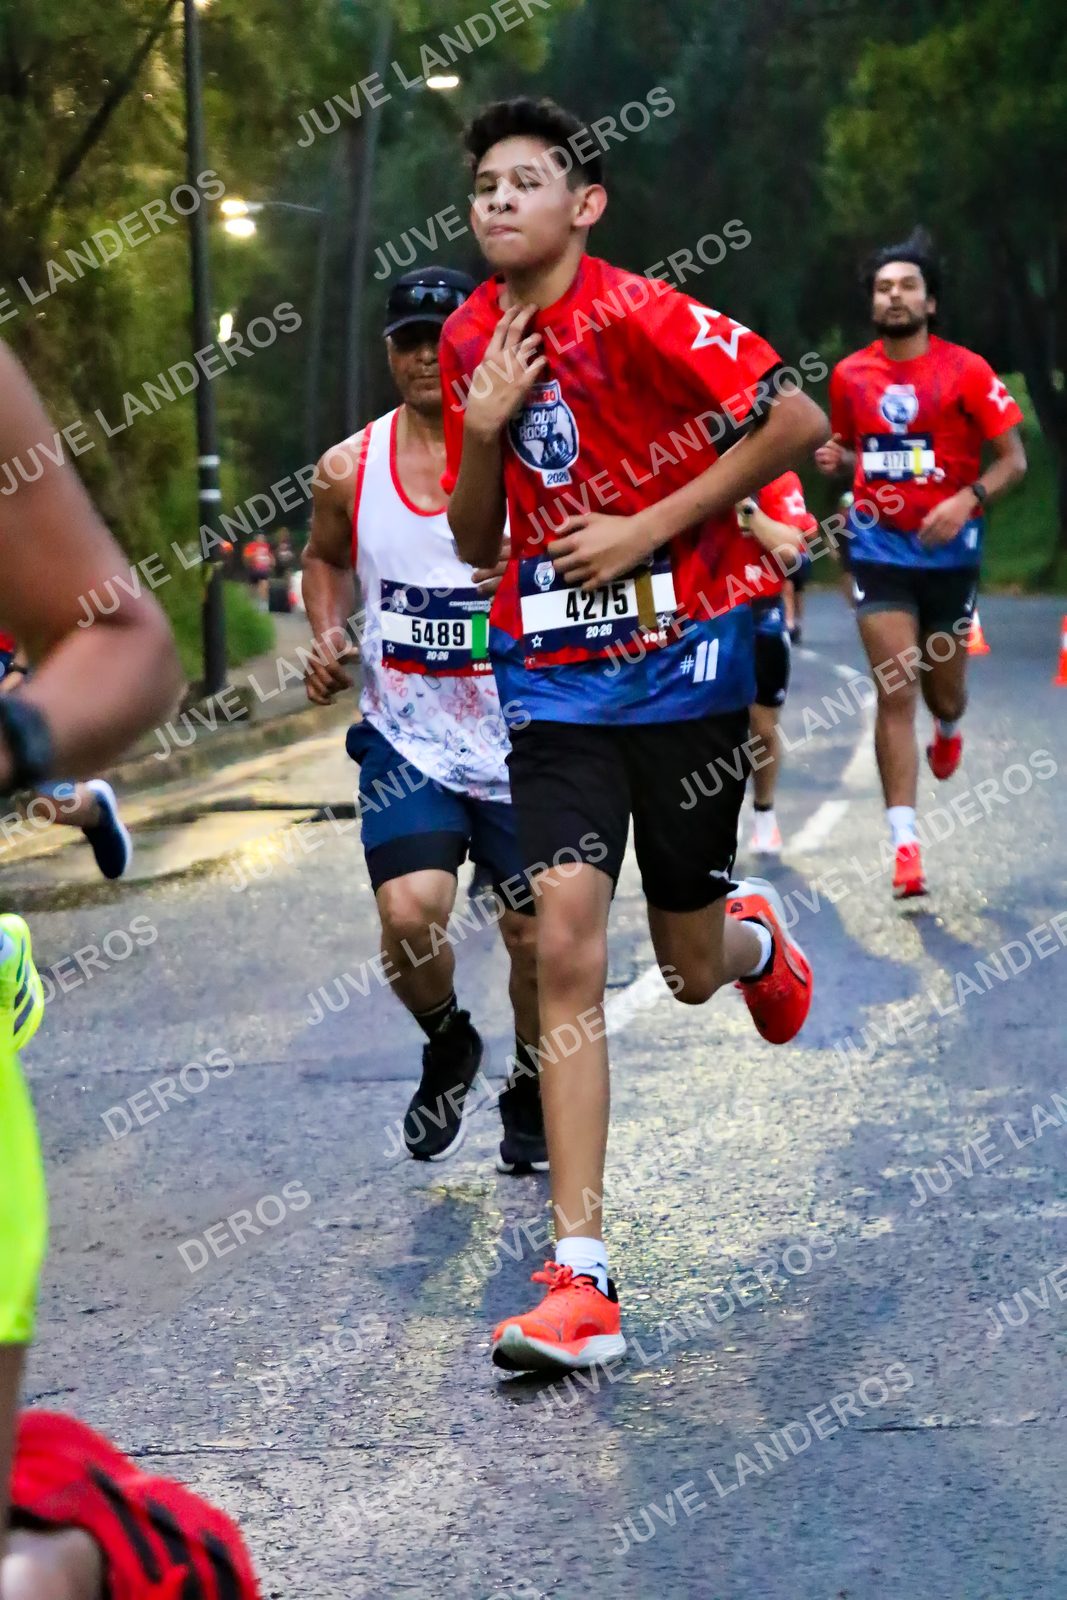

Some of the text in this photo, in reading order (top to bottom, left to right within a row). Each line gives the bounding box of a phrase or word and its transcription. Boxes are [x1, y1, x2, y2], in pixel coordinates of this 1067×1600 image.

[519, 425, 548, 440] Race
[566, 582, 628, 622] 4275
[412, 620, 465, 646] 5489
[586, 624, 612, 638] 20-26
[643, 631, 667, 644] 10K
